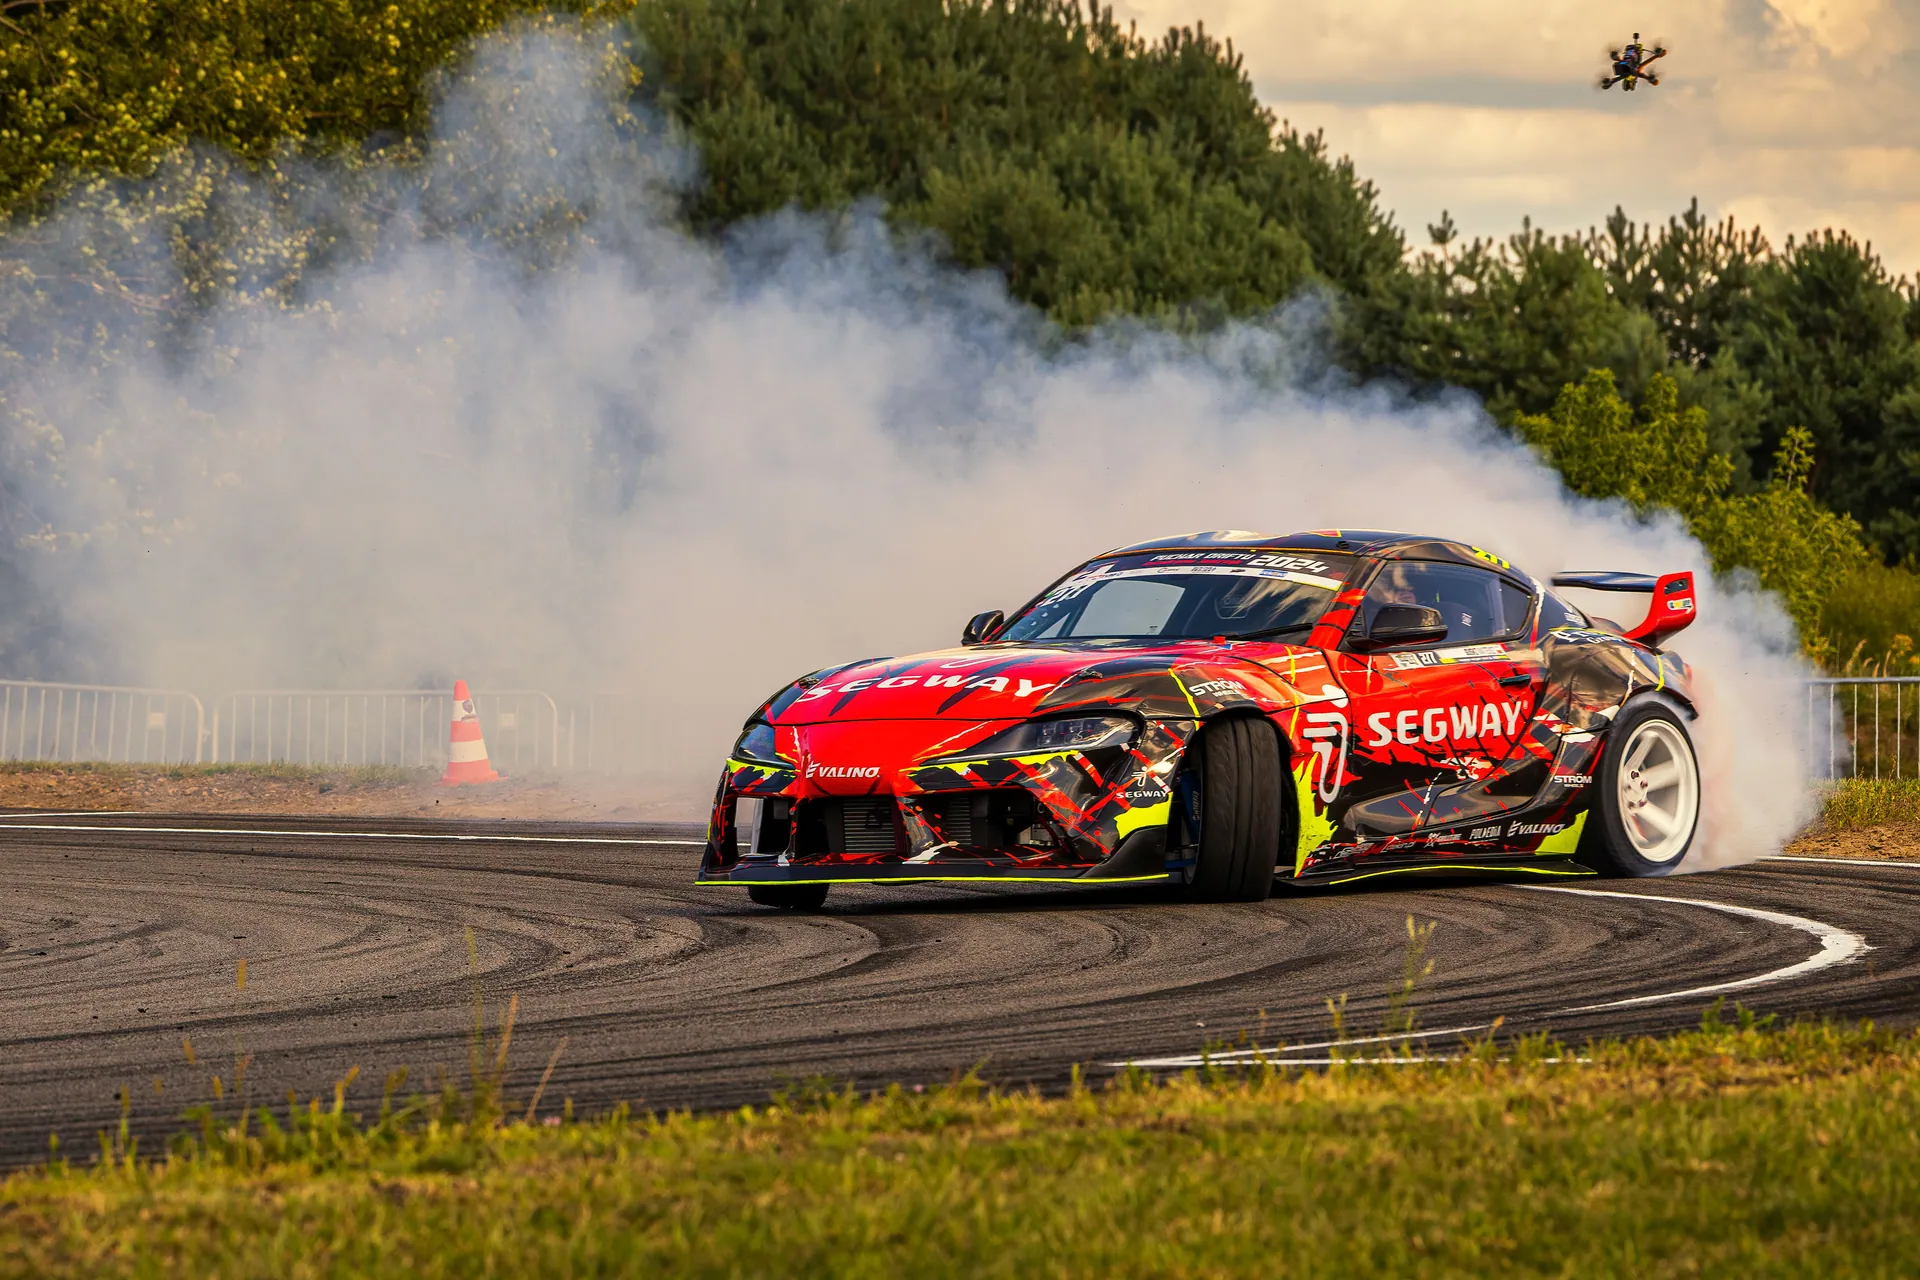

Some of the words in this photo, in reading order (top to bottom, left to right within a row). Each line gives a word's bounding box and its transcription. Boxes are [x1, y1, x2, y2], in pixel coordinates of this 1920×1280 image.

[1247, 555, 1330, 574] 2024
[797, 674, 1057, 703] SEGWAY
[1189, 677, 1247, 696] STRÖM
[1367, 701, 1523, 748] SEGWAY
[1554, 772, 1593, 784] STRÖM
[1116, 790, 1168, 799] SEGWAY
